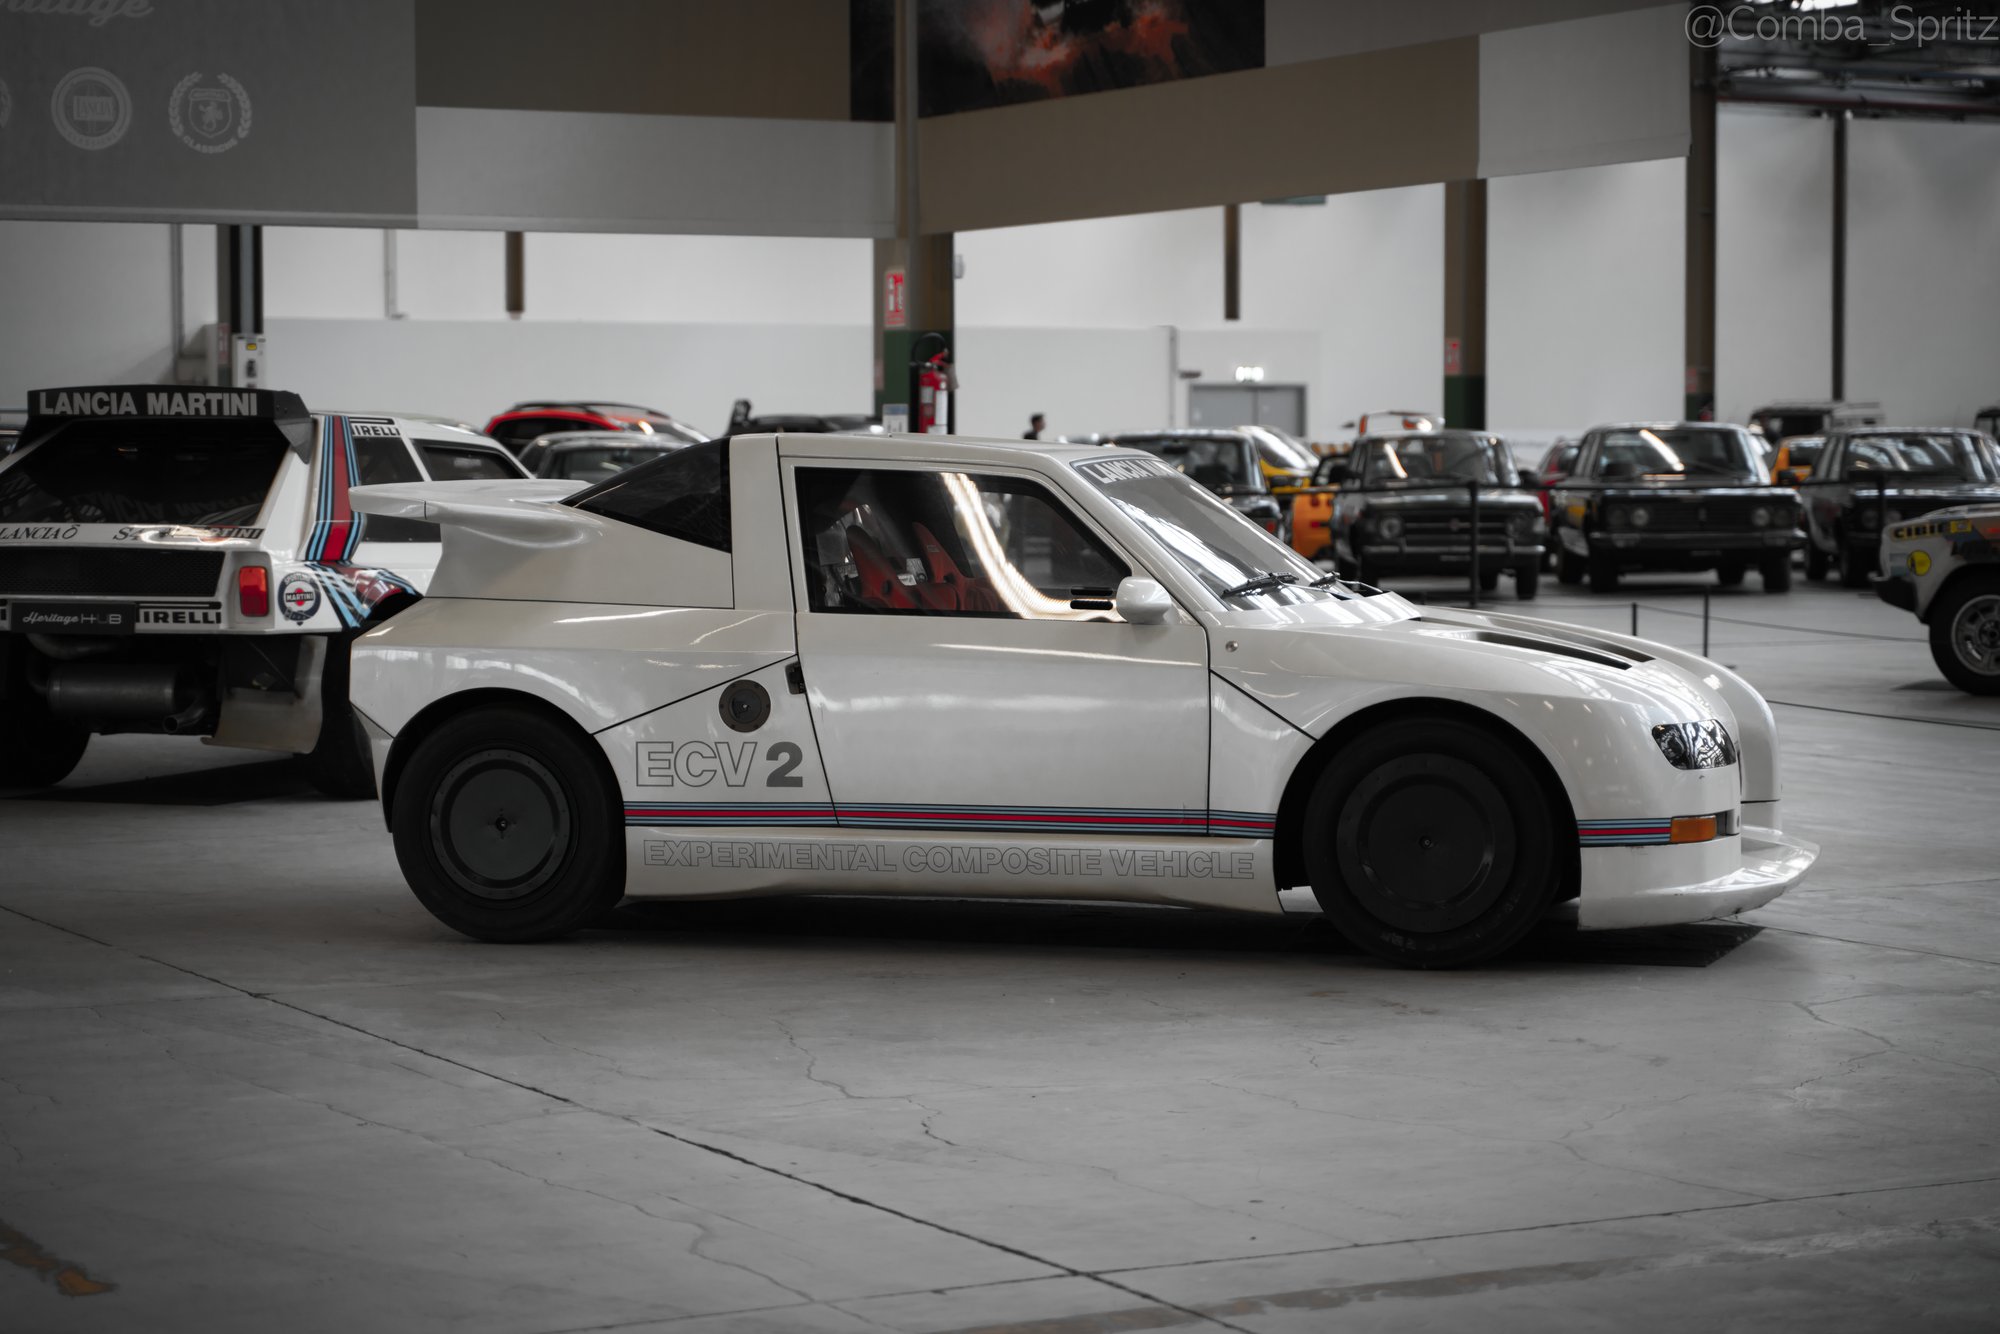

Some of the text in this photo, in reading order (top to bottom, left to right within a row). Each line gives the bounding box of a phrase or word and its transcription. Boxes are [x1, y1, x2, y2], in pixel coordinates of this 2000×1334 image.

[39, 392, 257, 416] LANCIA MARTINI
[1082, 460, 1154, 484] LANCIA
[286, 593, 314, 602] MARTINI
[22, 611, 79, 625] Heritage
[644, 840, 1254, 879] EXPERIMENTAL COMPOSITE VEHICLE
